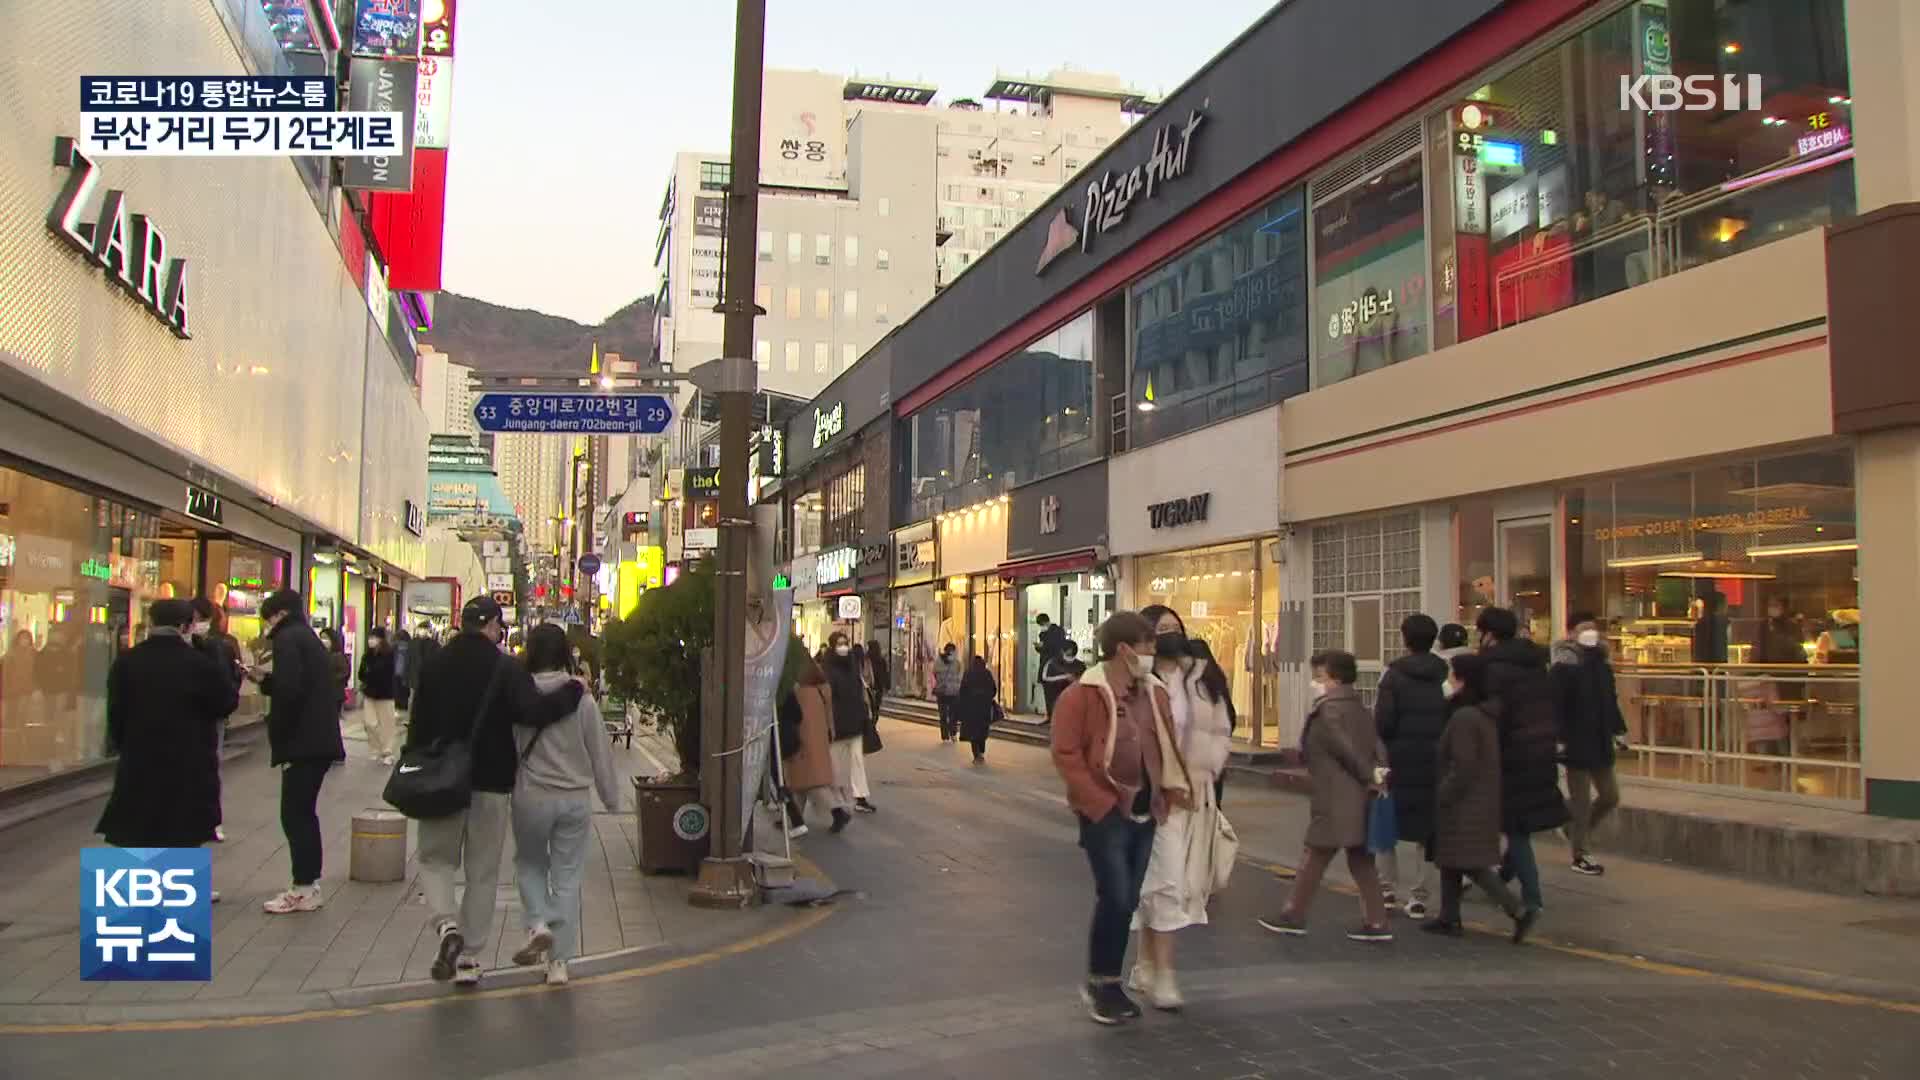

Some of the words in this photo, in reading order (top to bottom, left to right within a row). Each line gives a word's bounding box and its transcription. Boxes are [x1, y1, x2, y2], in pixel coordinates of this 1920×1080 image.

[780, 140, 826, 162] 쌍용
[1081, 166, 1142, 254] Pizza
[1145, 109, 1203, 199] Hut
[46, 136, 192, 340] ZARA
[479, 405, 497, 420] 33
[507, 396, 639, 417] 중앙대로702번길
[647, 407, 666, 422] 29
[502, 417, 579, 432] Jungang-daero
[581, 416, 642, 431] 702beon-gil
